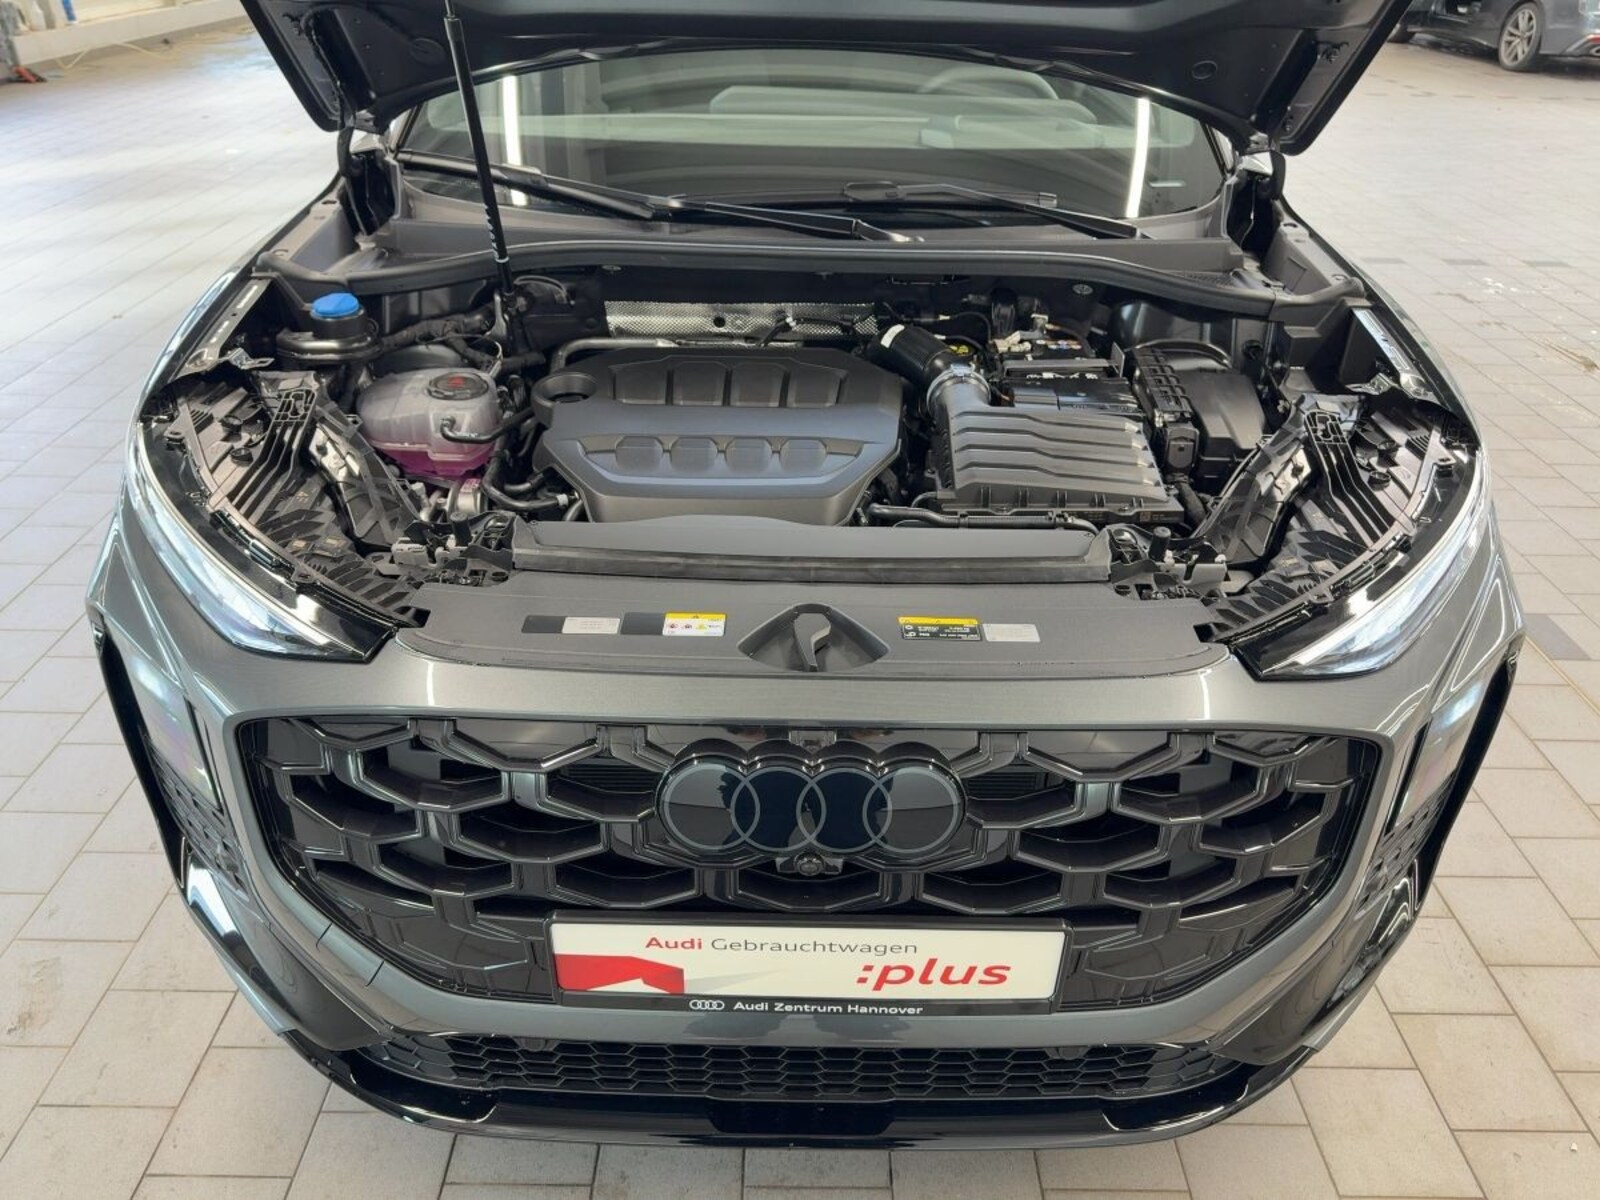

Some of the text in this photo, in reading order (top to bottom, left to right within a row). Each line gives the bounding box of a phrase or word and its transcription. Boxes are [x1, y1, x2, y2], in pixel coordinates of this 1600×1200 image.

[645, 937, 918, 957] Audi Gebrauchtwagen
[733, 1001, 924, 1015] Audi Zentrum Hannover
